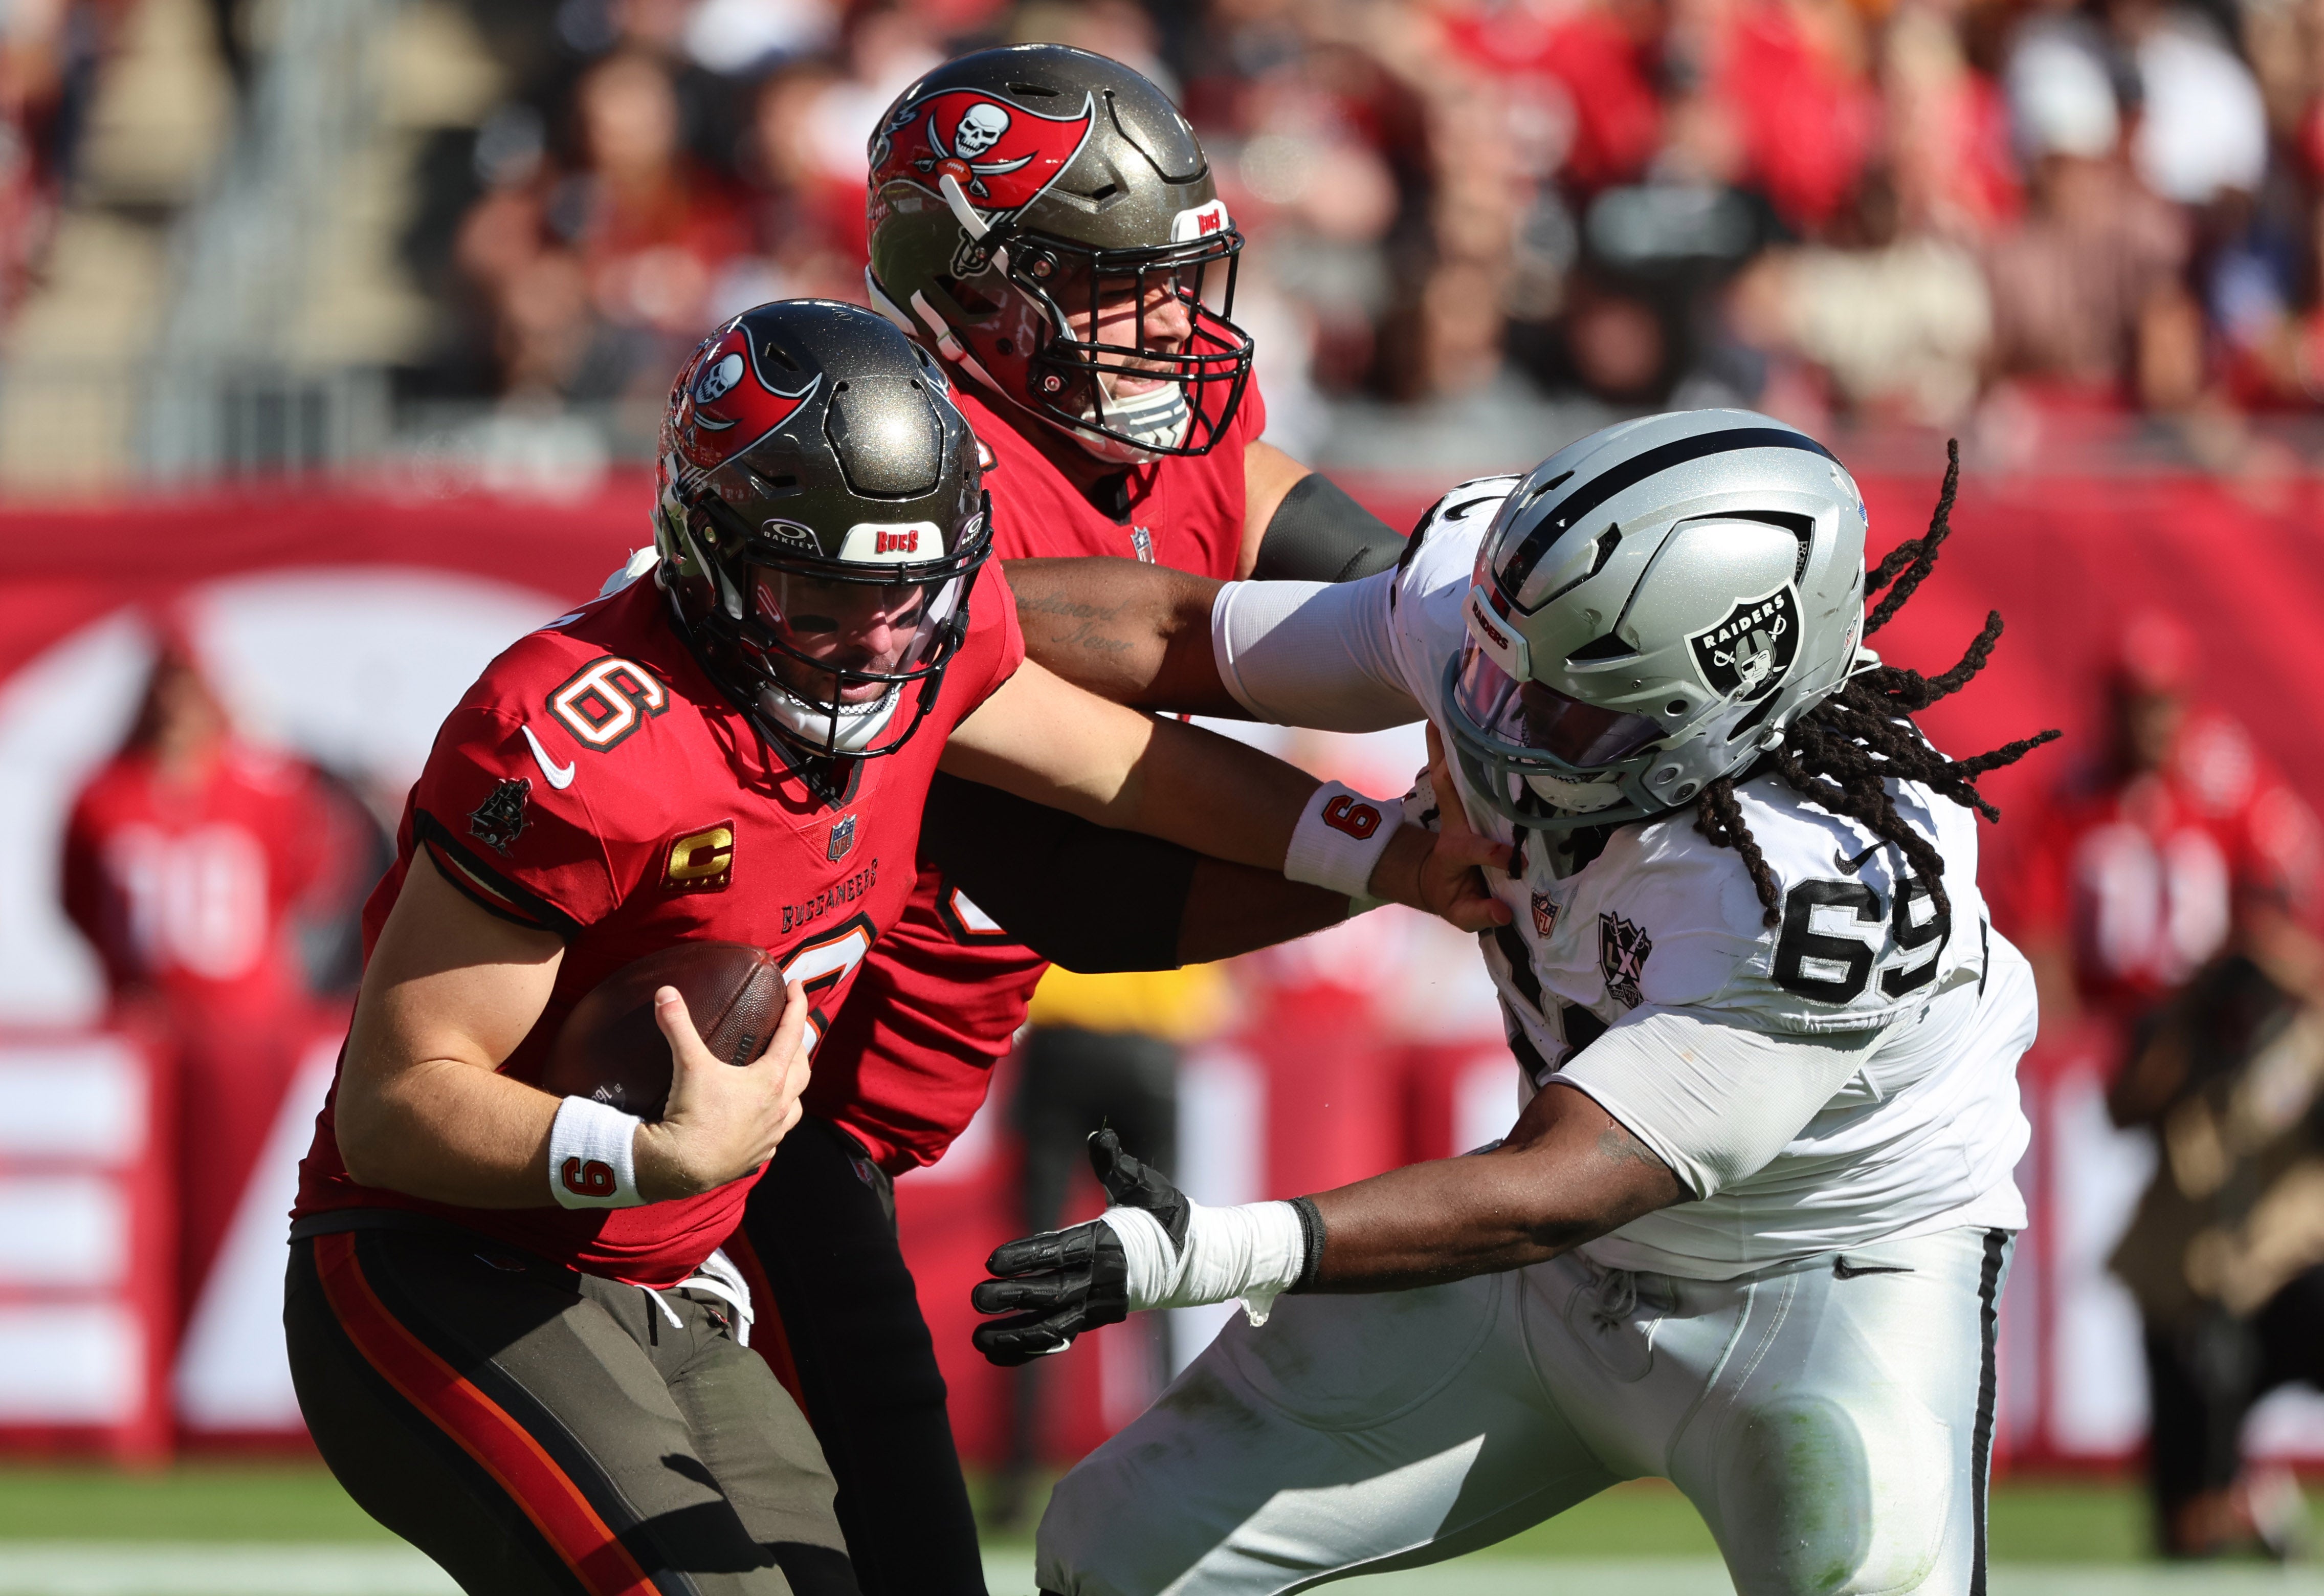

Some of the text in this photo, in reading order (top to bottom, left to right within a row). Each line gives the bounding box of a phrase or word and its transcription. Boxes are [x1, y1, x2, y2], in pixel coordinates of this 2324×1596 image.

[764, 531, 813, 550] OAKLEY
[876, 530, 919, 553] BUCS
[1472, 600, 1509, 650] RAIDERS
[1702, 595, 1784, 649] RAIDERS
[546, 654, 670, 754] 6
[669, 828, 733, 880] C
[832, 835, 851, 856] NFL
[781, 857, 878, 934] BUCCANEERS
[1767, 872, 1955, 1010] 69
